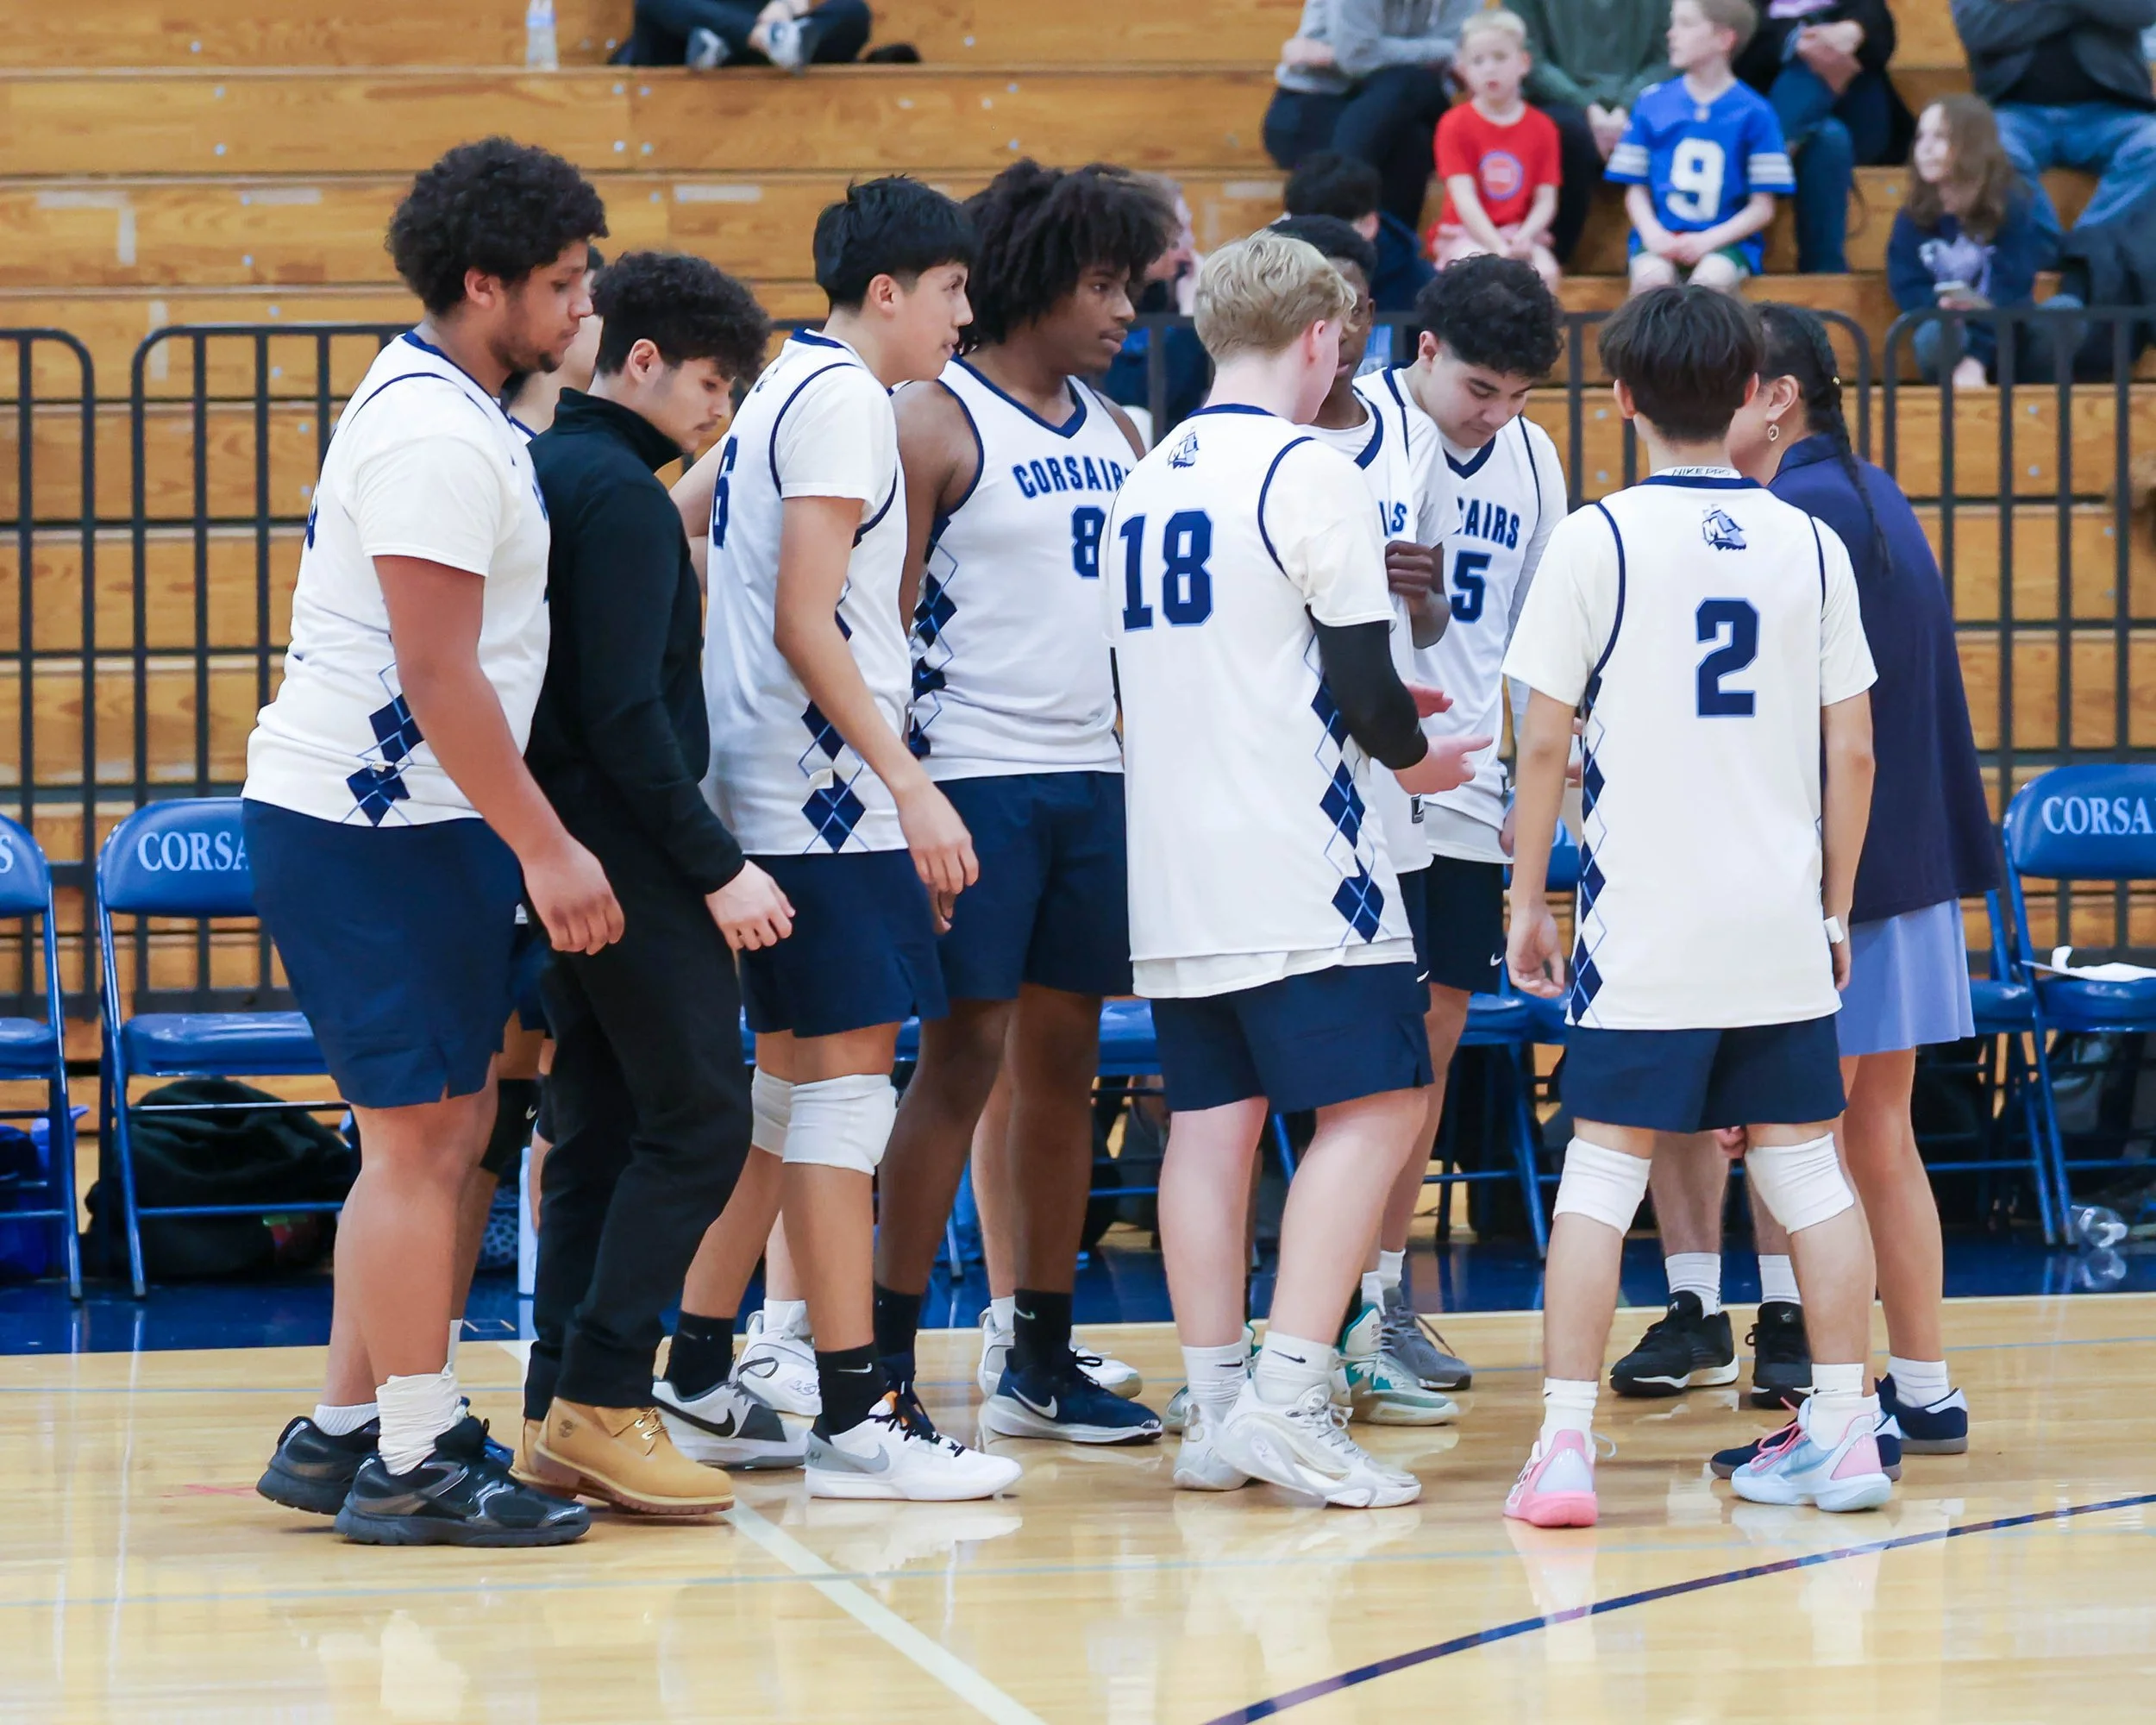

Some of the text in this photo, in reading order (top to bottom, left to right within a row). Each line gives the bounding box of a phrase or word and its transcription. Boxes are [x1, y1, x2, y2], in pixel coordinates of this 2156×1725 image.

[1665, 137, 1725, 222] 9
[1012, 455, 1129, 499] CORSAIR
[1071, 505, 1106, 580] 8
[1119, 508, 1214, 632] 18
[1450, 549, 1492, 624] 5
[1695, 597, 1759, 718] 2
[2042, 796, 2156, 835] CORSA
